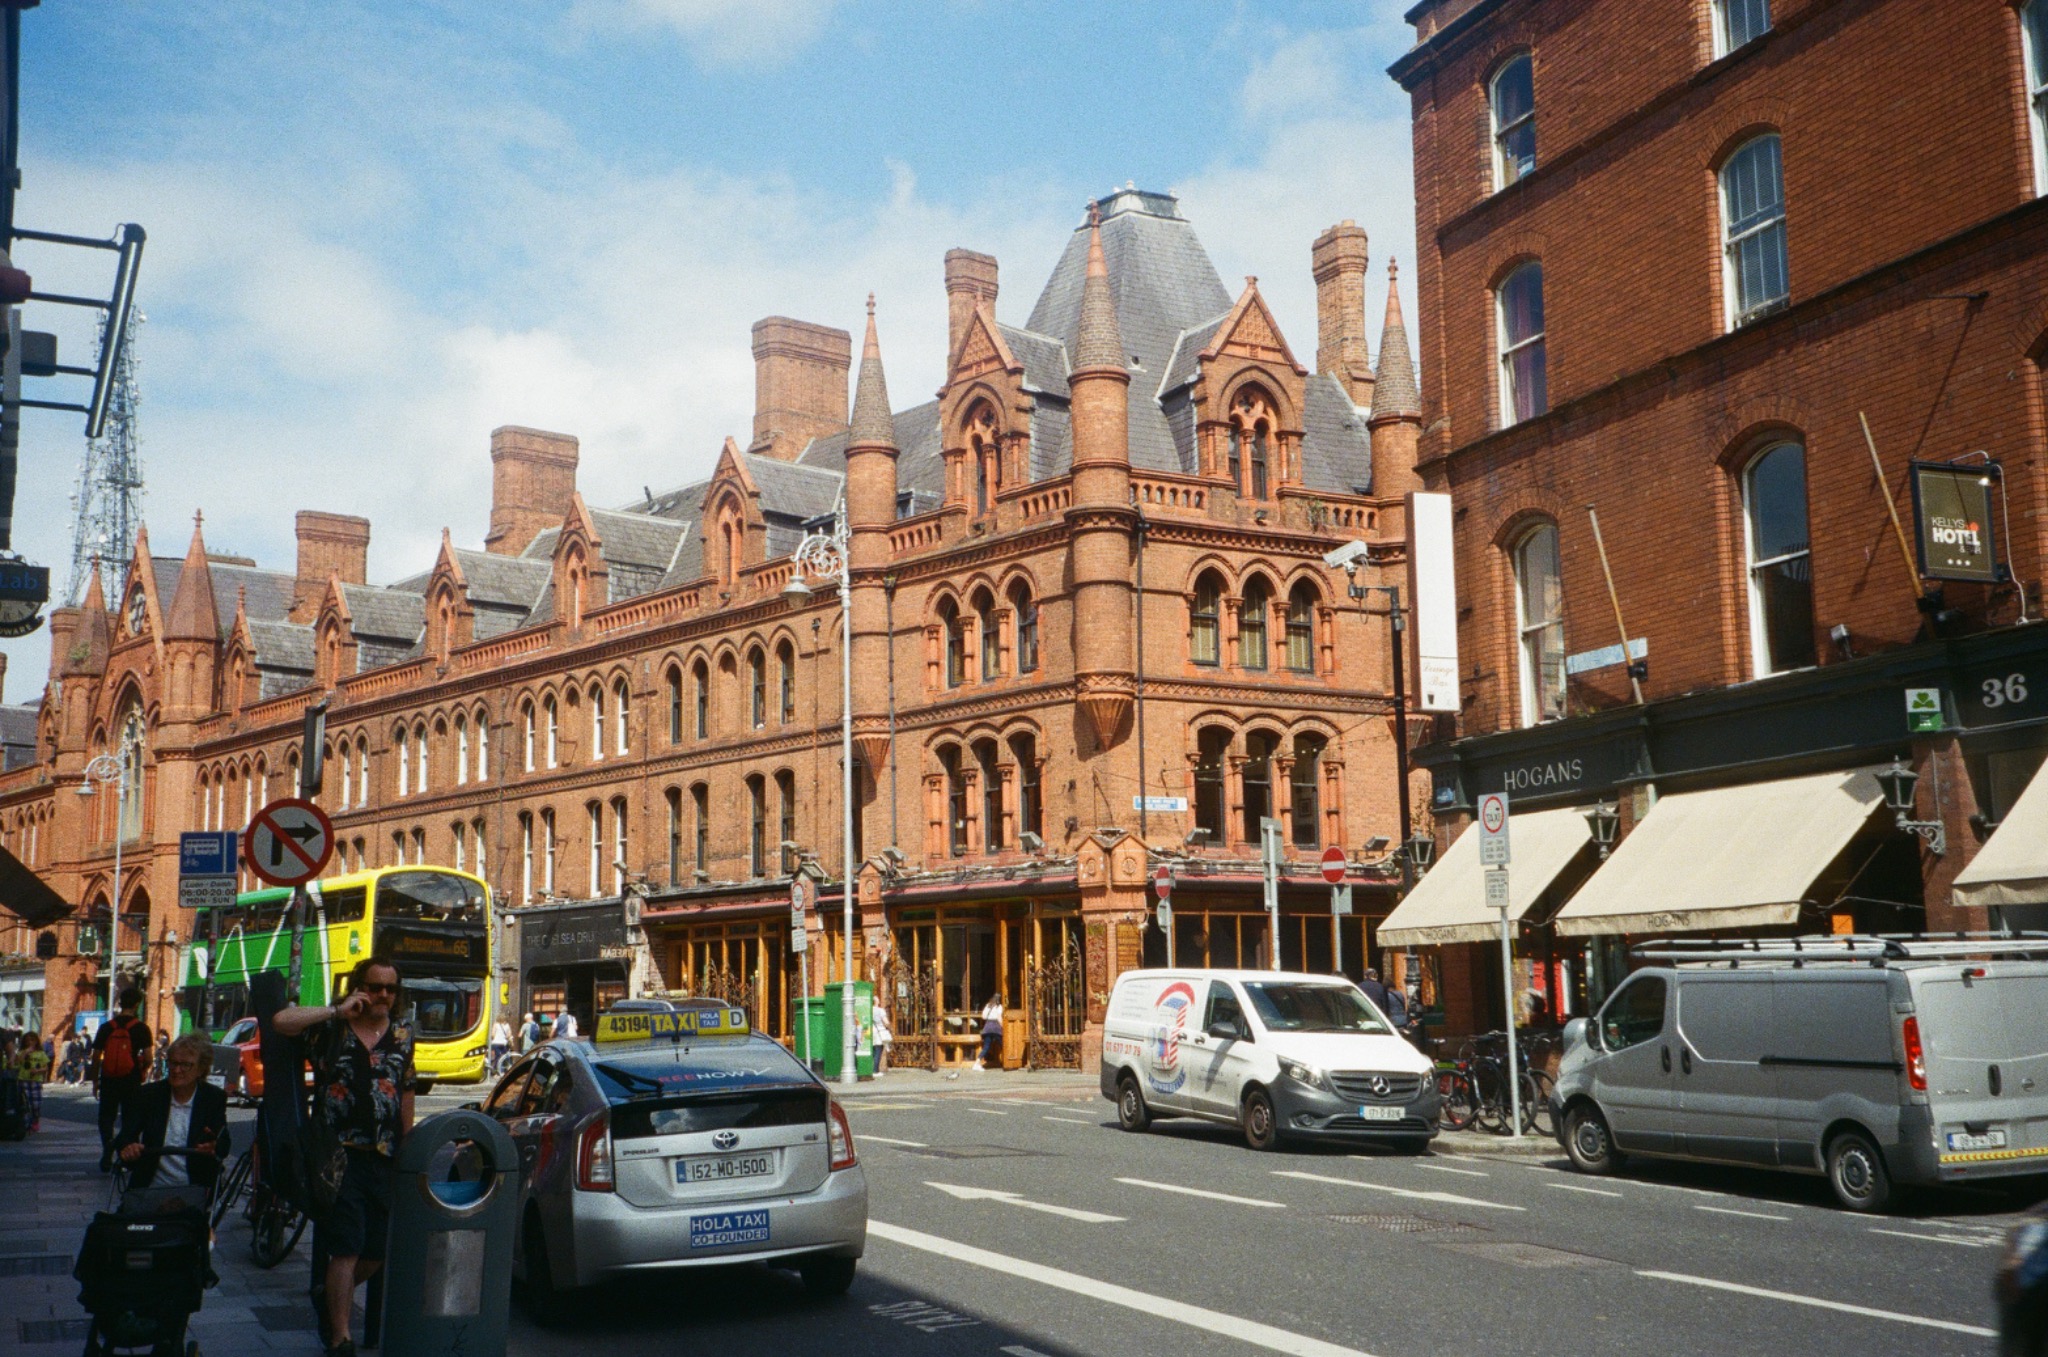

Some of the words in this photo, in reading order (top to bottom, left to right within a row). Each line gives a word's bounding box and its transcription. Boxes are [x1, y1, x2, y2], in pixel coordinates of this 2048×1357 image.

[1932, 527, 1981, 546] HOTEL
[1982, 673, 2028, 708] 36
[1504, 759, 1583, 791] HOGANS
[453, 940, 468, 954] 65
[542, 932, 575, 946] CELSEA
[610, 1015, 649, 1033] 43194
[652, 1011, 696, 1033] TAXI
[700, 1012, 719, 1020] HOLA
[730, 1011, 743, 1026] D
[657, 1071, 744, 1084] REENOW
[691, 1158, 767, 1180] 152-MO-1500
[692, 1218, 731, 1233] HOLA
[735, 1213, 767, 1229] TAXI
[692, 1228, 768, 1246] CO-FOUNDER
